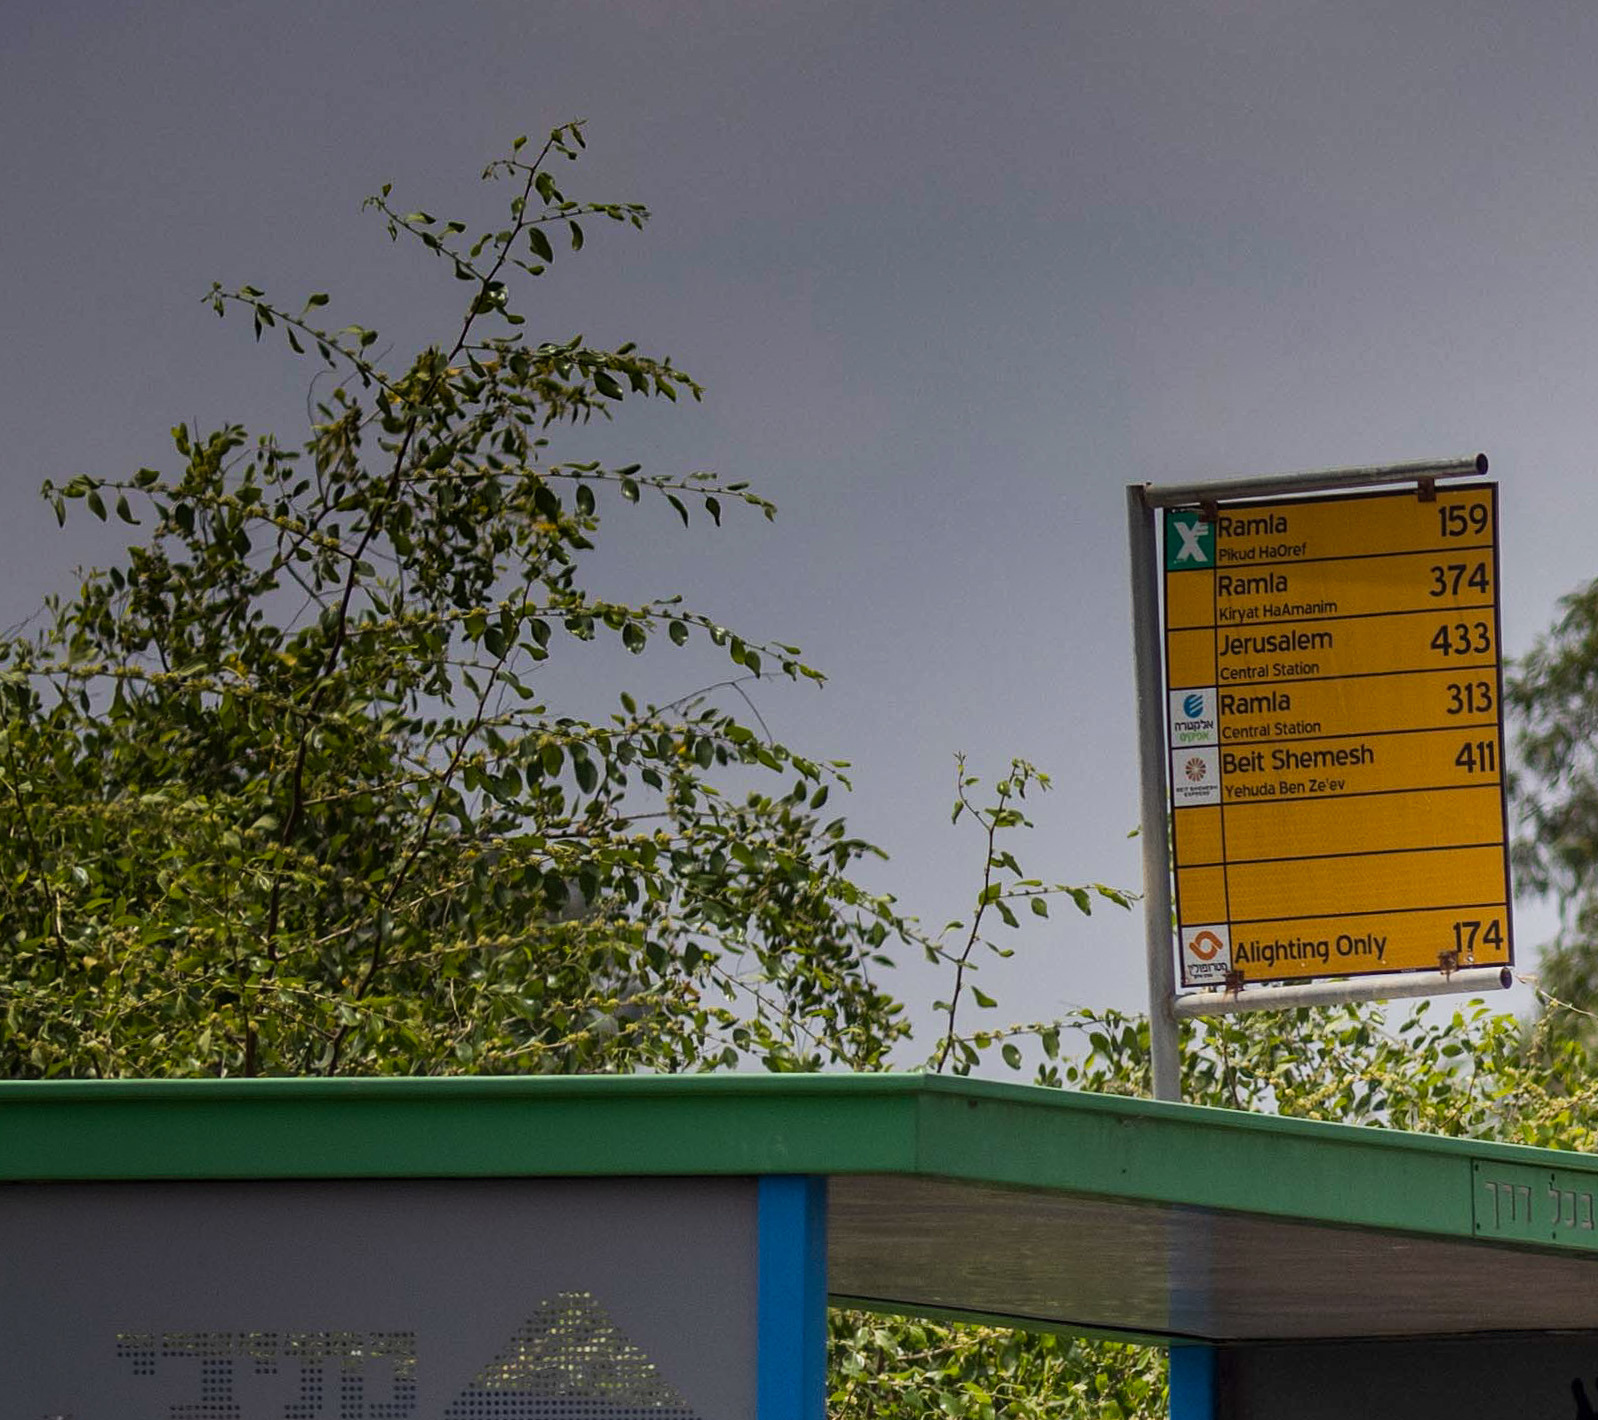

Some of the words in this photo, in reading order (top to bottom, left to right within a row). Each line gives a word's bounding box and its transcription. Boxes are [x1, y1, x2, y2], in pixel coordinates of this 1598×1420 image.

[1218, 514, 1287, 538] Ramla
[1439, 503, 1488, 537] 159
[1219, 547, 1256, 562] Pikud
[1259, 542, 1306, 560] HaOref
[1218, 572, 1287, 597] Ramla
[1429, 562, 1489, 597] 374
[1219, 605, 1259, 622] Kiryat
[1262, 601, 1337, 618] HaAmanim
[1219, 630, 1333, 656] Jerusalem
[1431, 622, 1491, 657] 433
[1220, 665, 1269, 681] Central
[1273, 661, 1319, 677] Station
[1220, 692, 1290, 716] Ramla
[1446, 681, 1493, 715] 313
[1222, 723, 1271, 739] Central
[1274, 720, 1321, 736] Station
[1223, 751, 1267, 775] Beit
[1272, 744, 1374, 770] Shemesh
[1455, 741, 1495, 773] 411
[1225, 783, 1275, 799] Yehuda
[1279, 780, 1305, 794] Ben
[1309, 778, 1345, 792] Ze'ev
[1235, 940, 1329, 967] Alighting
[1336, 936, 1386, 960] Only
[1453, 919, 1503, 953] 174
[1484, 1181, 1532, 1230] דרך
[1548, 1181, 1595, 1230] בכל
